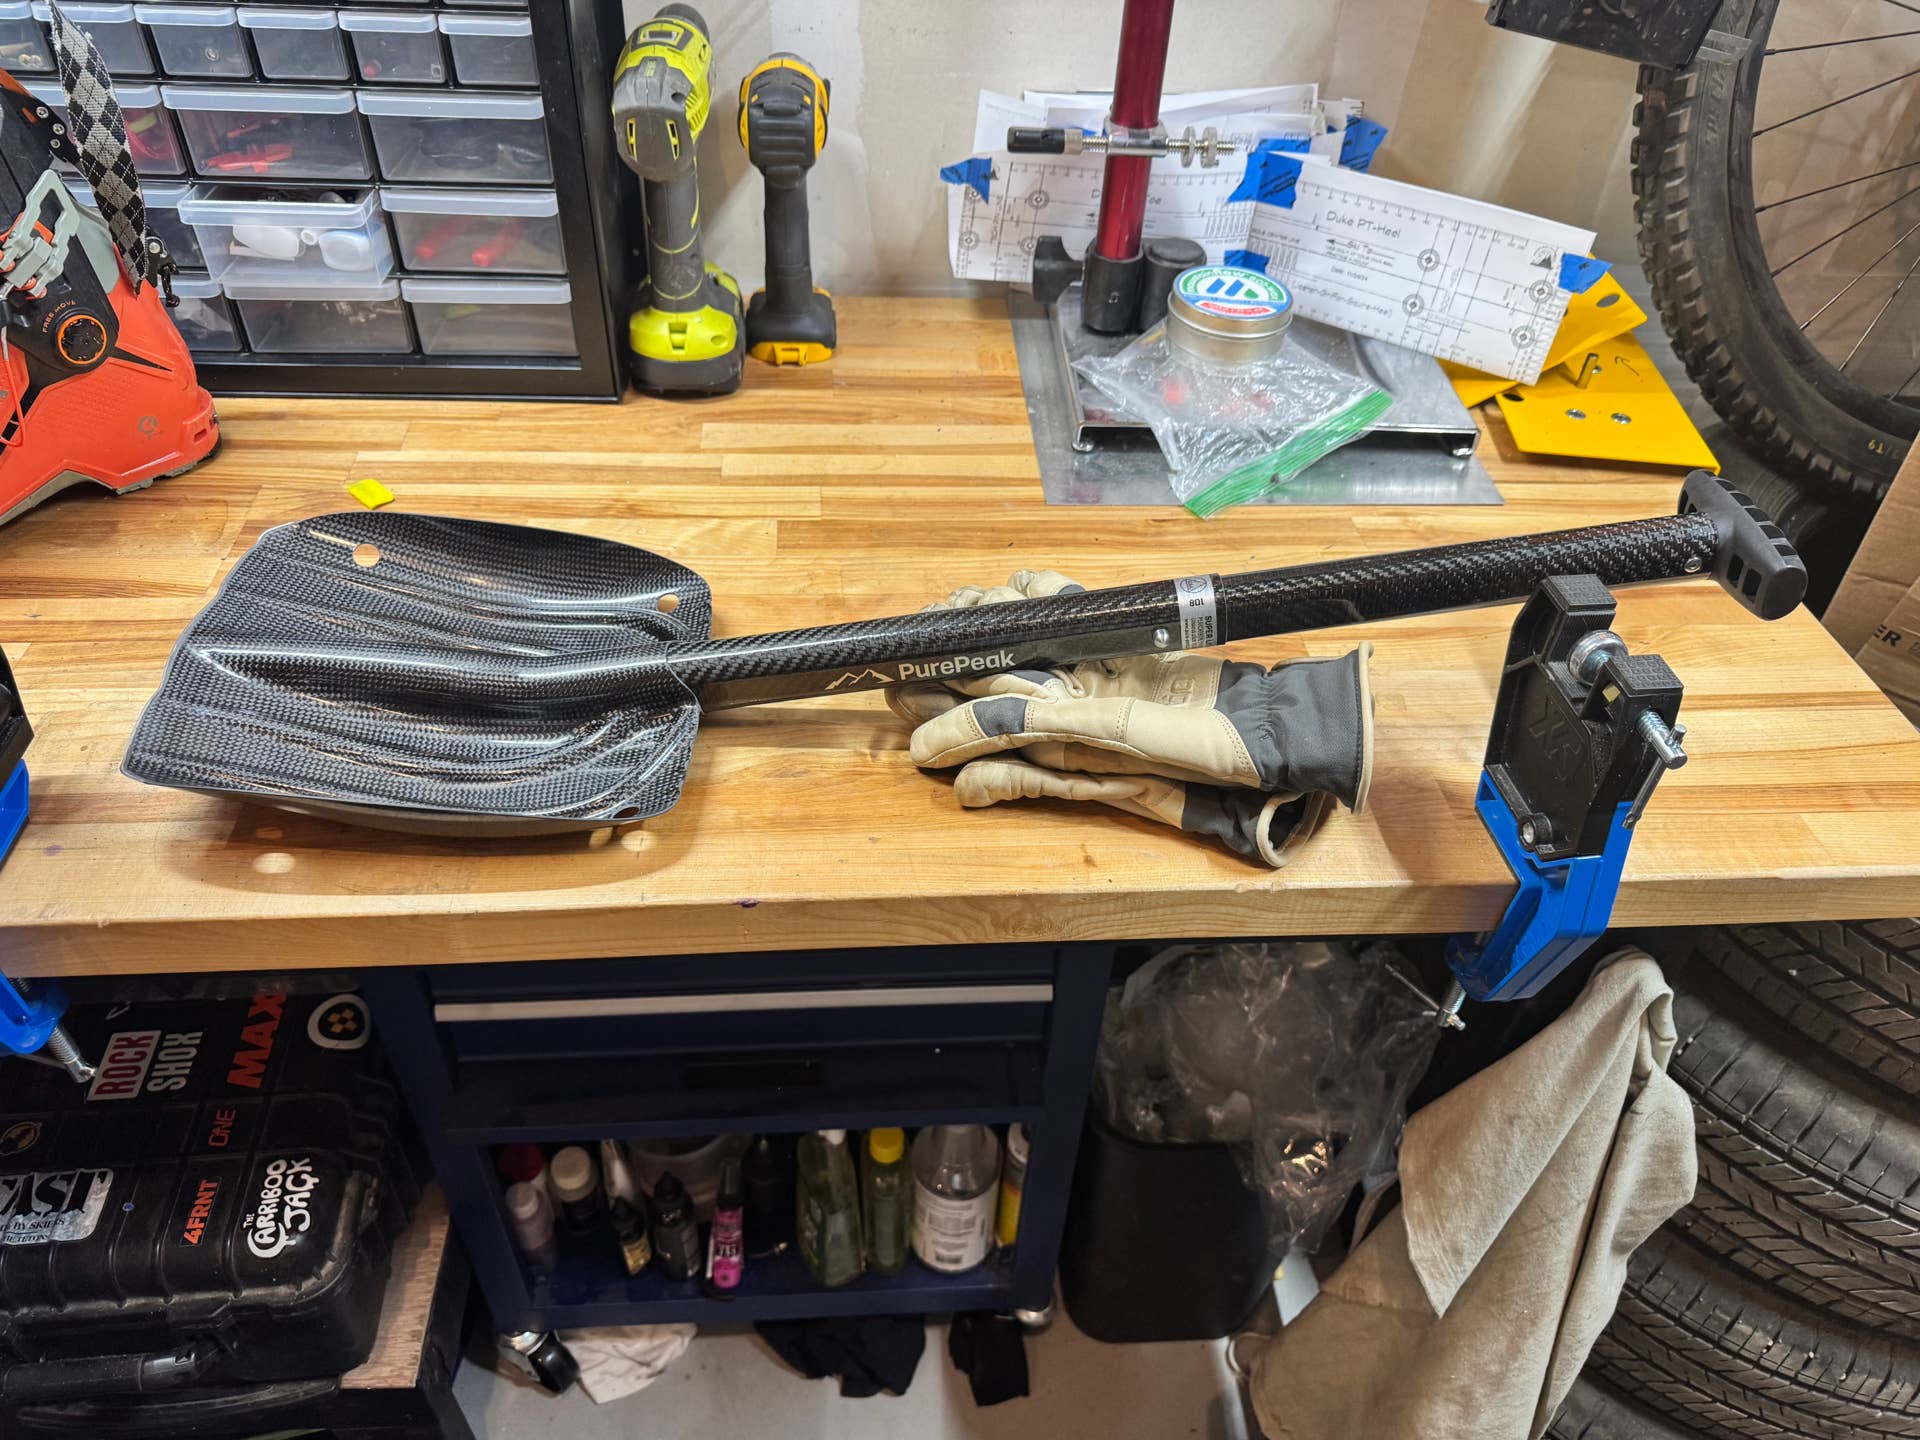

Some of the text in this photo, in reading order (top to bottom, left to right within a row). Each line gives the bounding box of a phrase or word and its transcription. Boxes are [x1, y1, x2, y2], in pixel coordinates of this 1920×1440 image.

[1326, 210, 1401, 239] Duke PT-Heel
[42, 300, 76, 333] FREE MOVE
[1204, 616, 1214, 638] SUPER
[898, 650, 1016, 680] PurePeak
[94, 1034, 156, 1095] ROCK
[147, 1031, 204, 1092] SHOX
[183, 1179, 219, 1245] 4FRNT
[247, 1159, 297, 1258] CARRIBOO
[283, 1157, 320, 1232] JACK
[243, 1212, 255, 1229] THE
